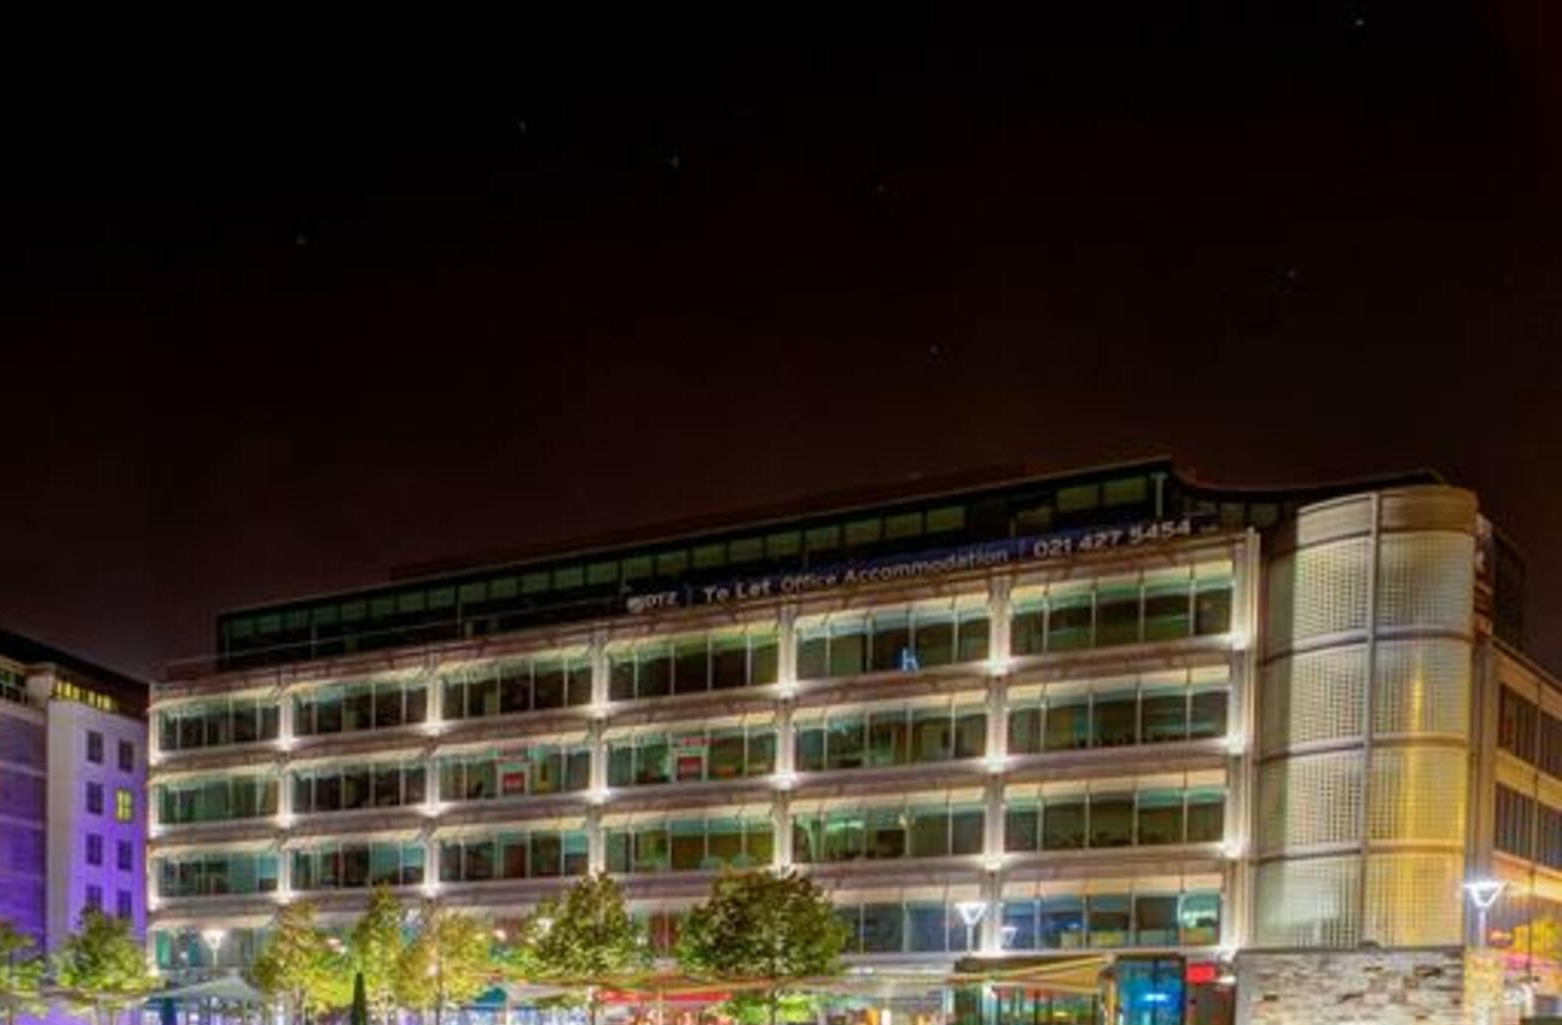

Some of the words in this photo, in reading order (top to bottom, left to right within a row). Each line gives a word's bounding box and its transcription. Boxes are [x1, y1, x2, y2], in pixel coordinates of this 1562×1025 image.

[702, 587, 730, 602] To
[737, 578, 771, 599] Let
[781, 573, 837, 593] Office
[843, 549, 1009, 584] Accommodation
[1033, 537, 1073, 558] 021
[1079, 530, 1124, 551] 427
[1129, 519, 1191, 545] 5454
